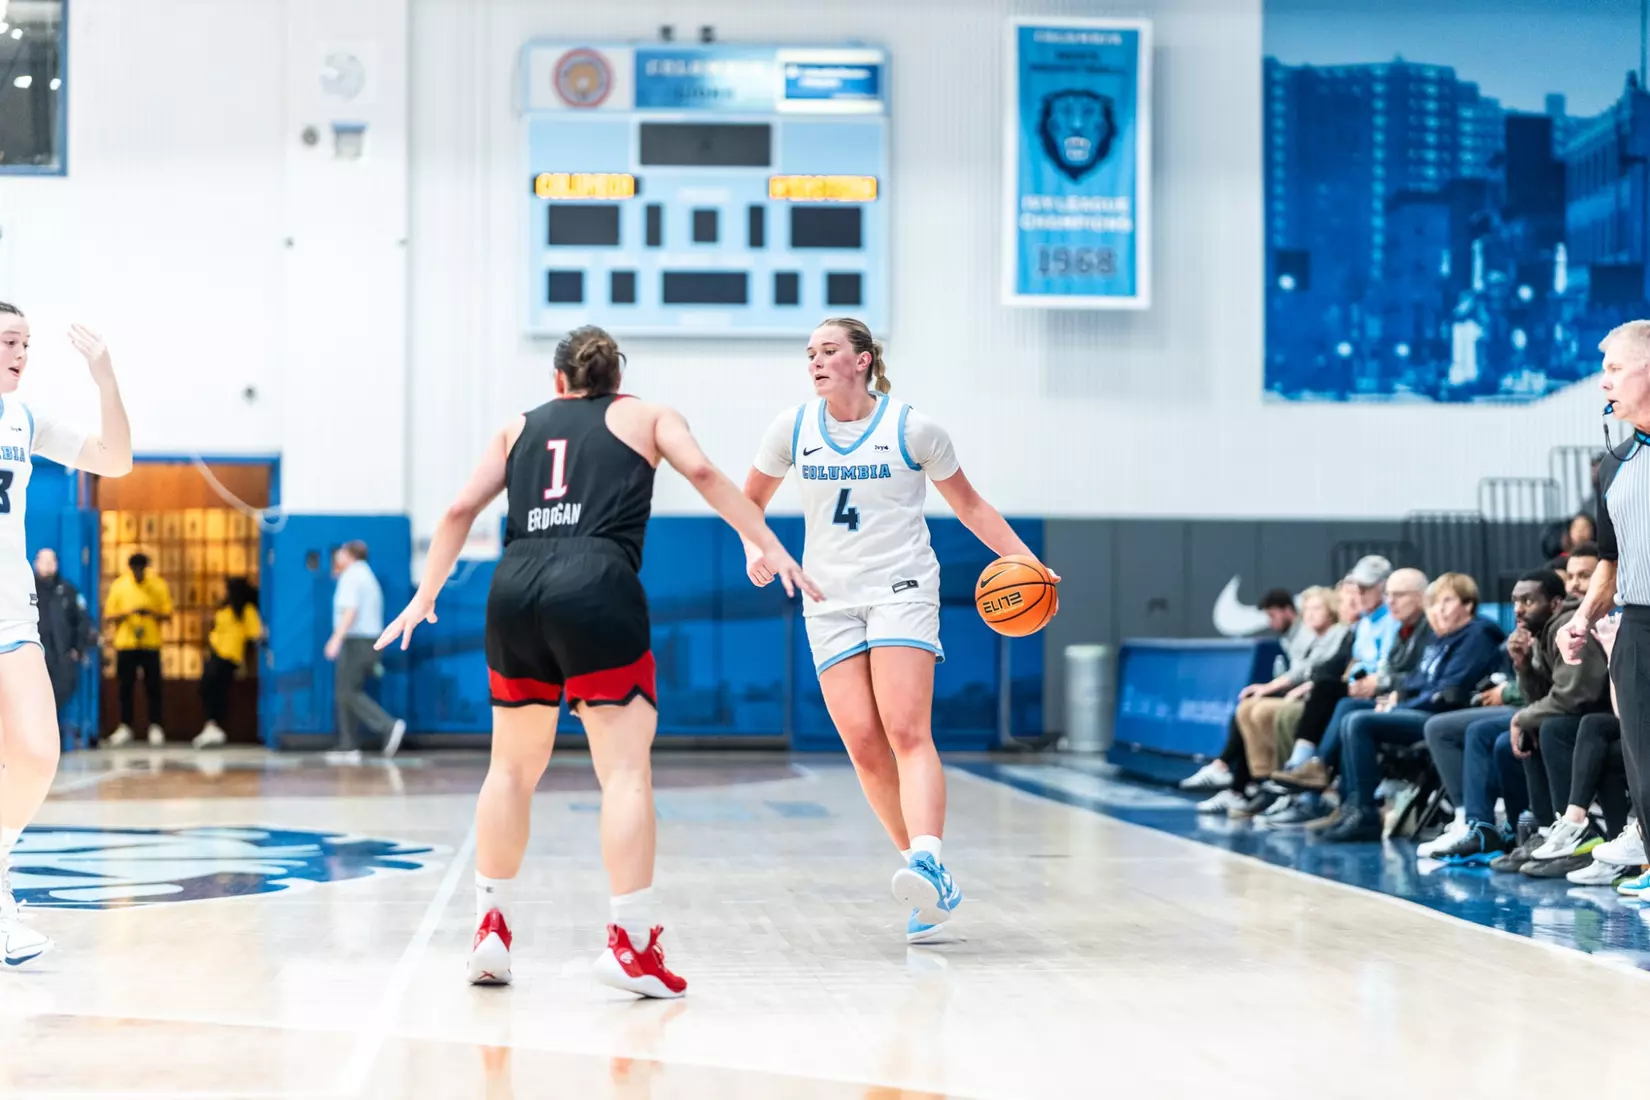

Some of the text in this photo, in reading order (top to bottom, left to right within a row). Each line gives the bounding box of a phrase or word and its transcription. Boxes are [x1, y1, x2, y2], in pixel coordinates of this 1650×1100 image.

[1036, 244, 1118, 278] 1968
[0, 446, 25, 462] BIA
[543, 438, 568, 500] 1
[802, 464, 892, 480] COLUMBIA
[832, 487, 861, 532] 4
[982, 591, 1023, 614] ELITE
